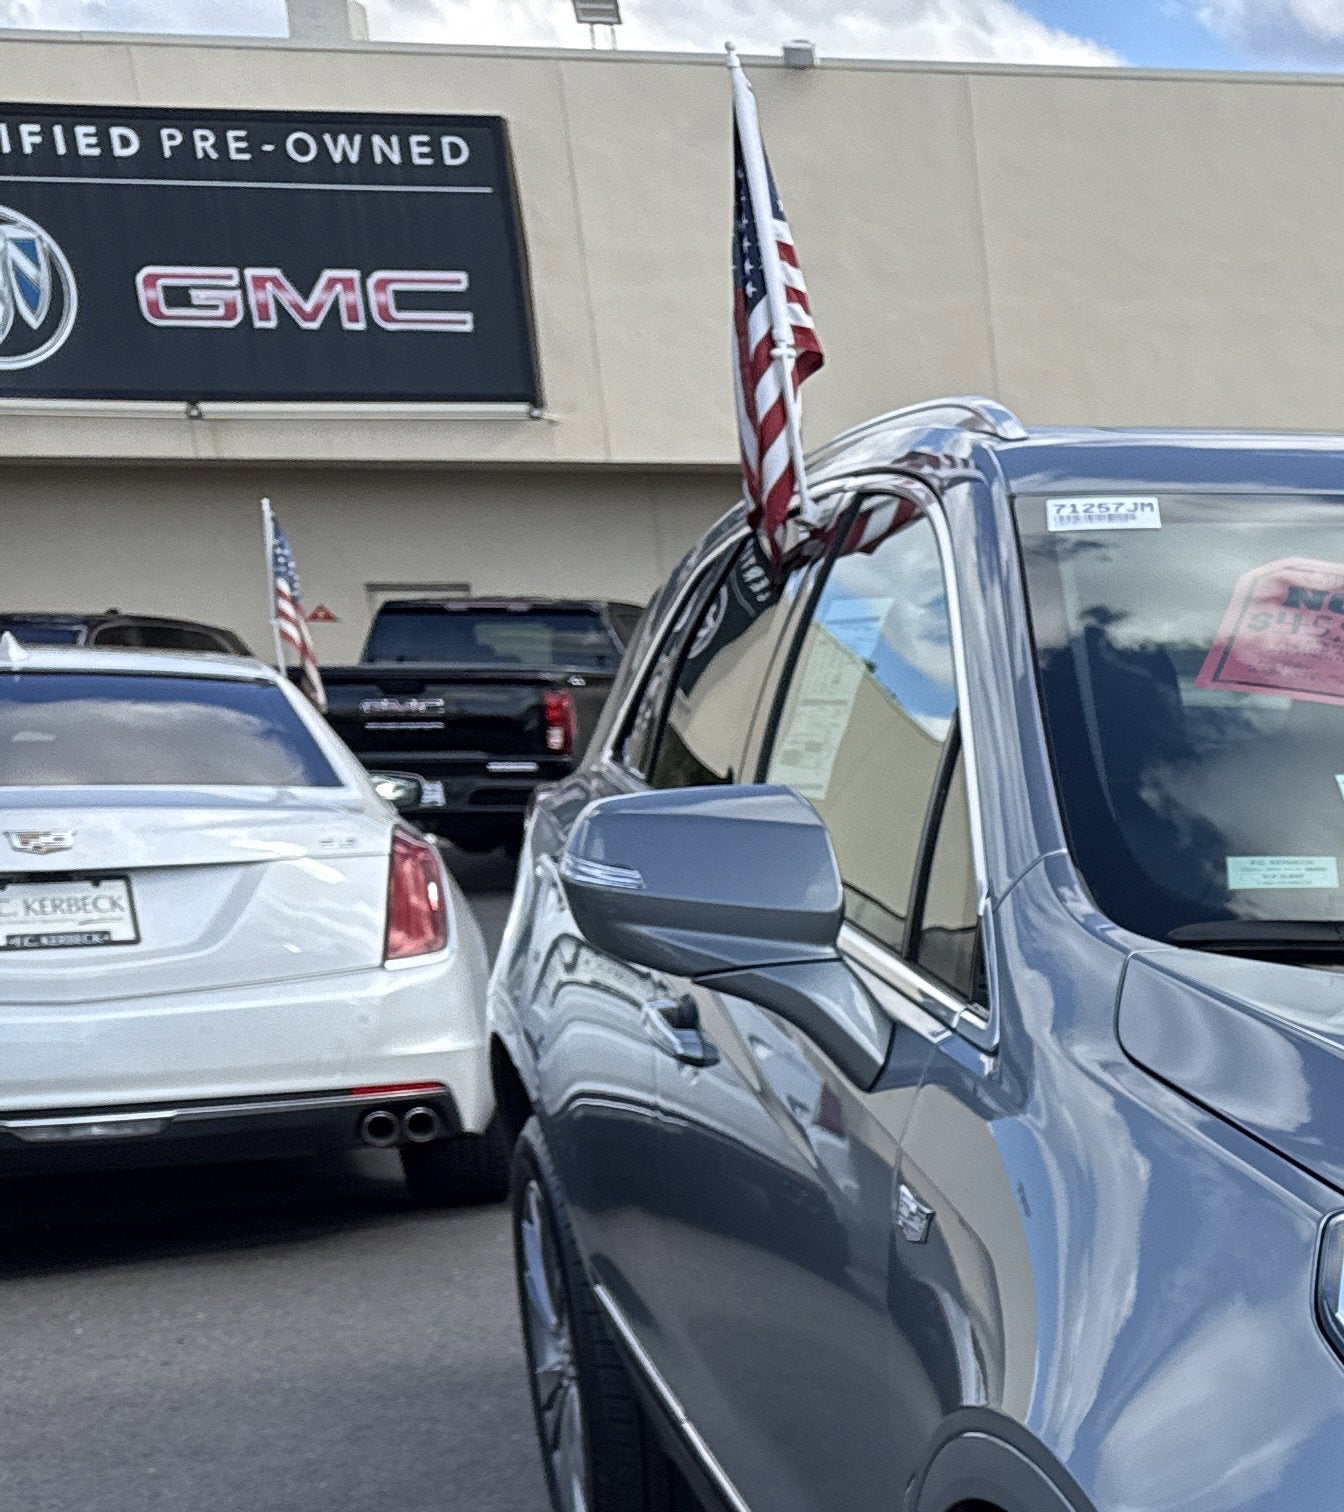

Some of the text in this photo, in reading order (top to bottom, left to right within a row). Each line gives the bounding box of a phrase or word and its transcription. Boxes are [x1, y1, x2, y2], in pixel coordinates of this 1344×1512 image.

[160, 127, 470, 166] PRE-OWNED
[136, 265, 474, 332] GMC
[1053, 502, 1154, 514] 71257JM
[22, 894, 126, 917] KERBECK
